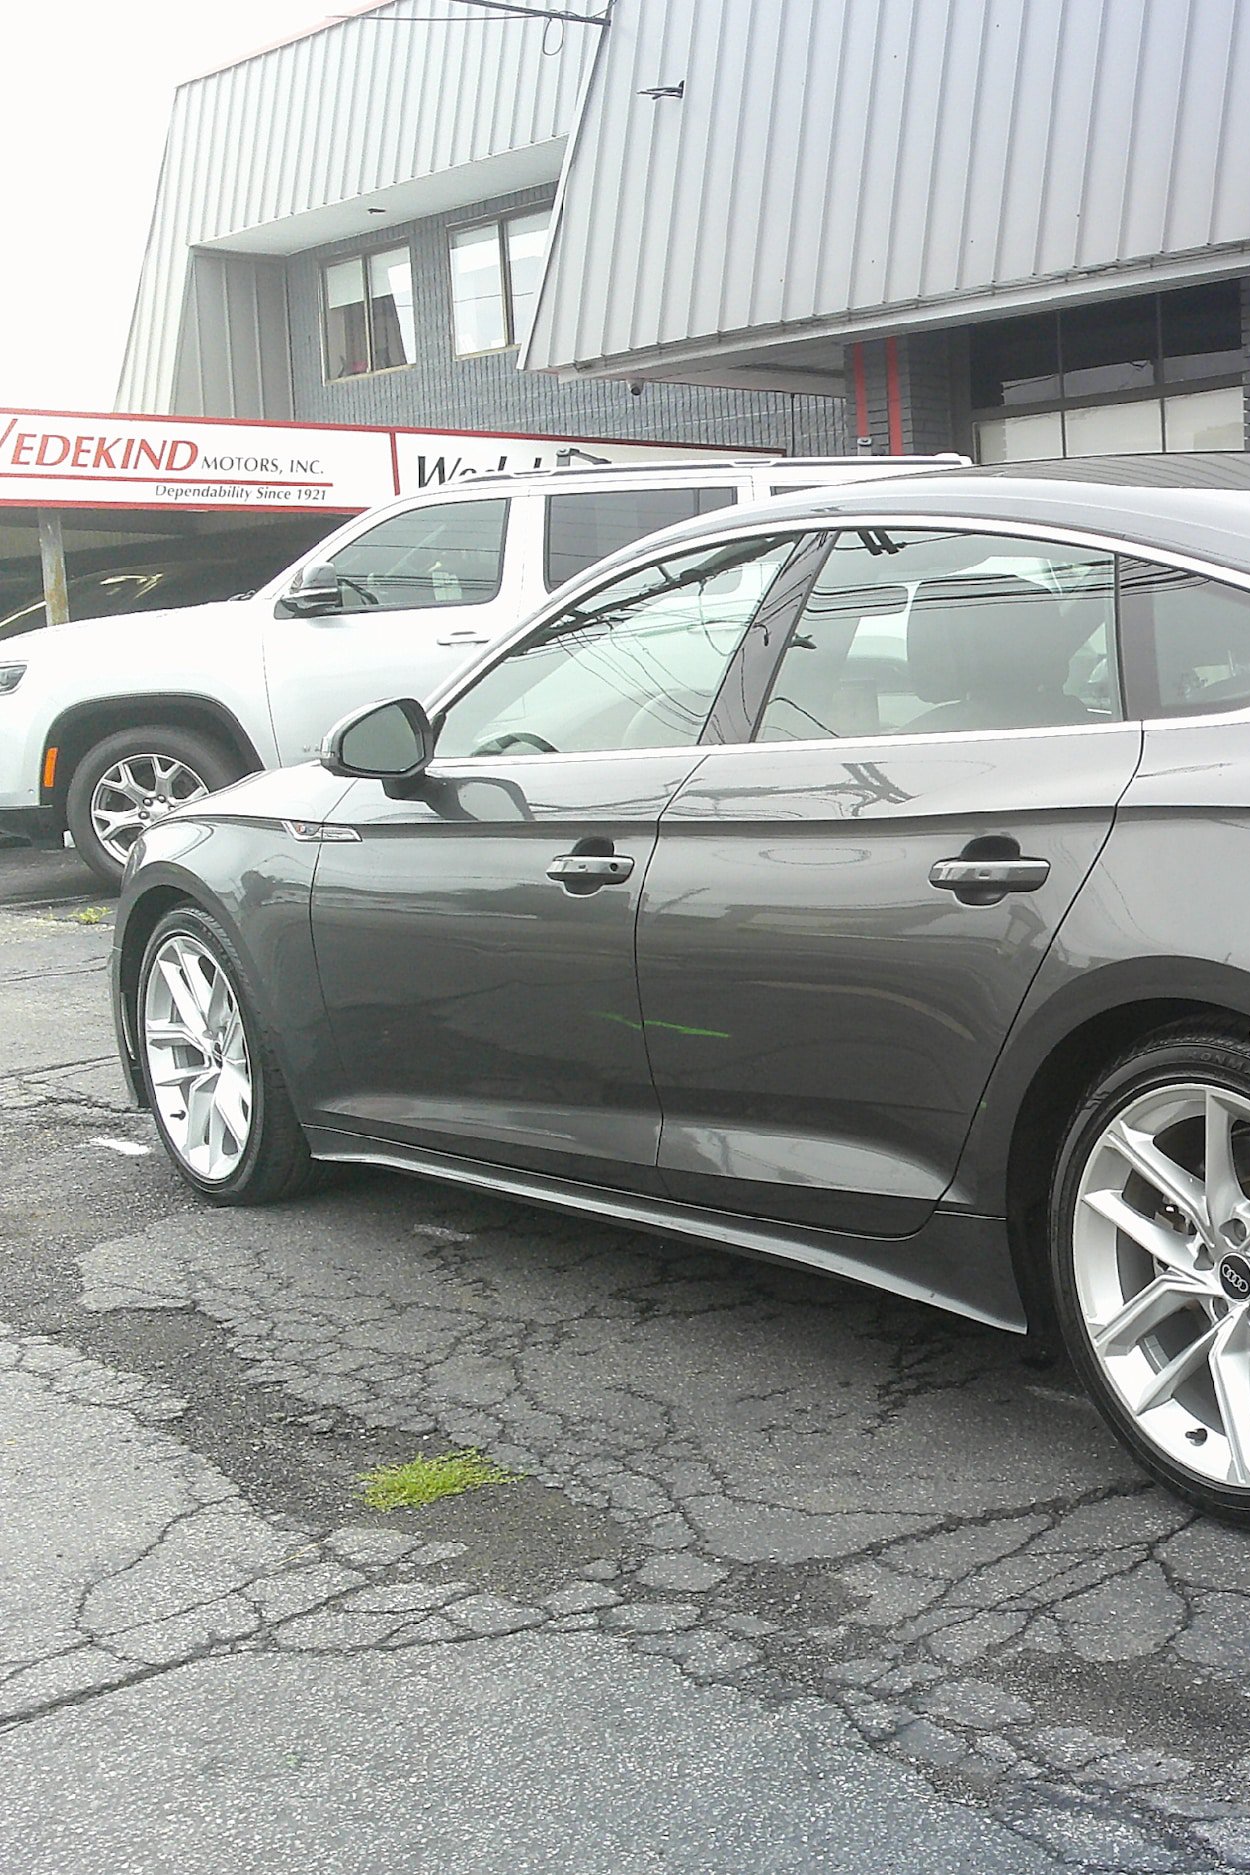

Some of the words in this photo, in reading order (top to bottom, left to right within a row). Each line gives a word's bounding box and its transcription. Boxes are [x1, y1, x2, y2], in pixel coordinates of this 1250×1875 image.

[201, 455, 283, 475] MOTORS,
[289, 459, 325, 475] INC.
[155, 484, 252, 501] Dependability
[256, 487, 291, 500] Since
[297, 488, 327, 501] 1921
